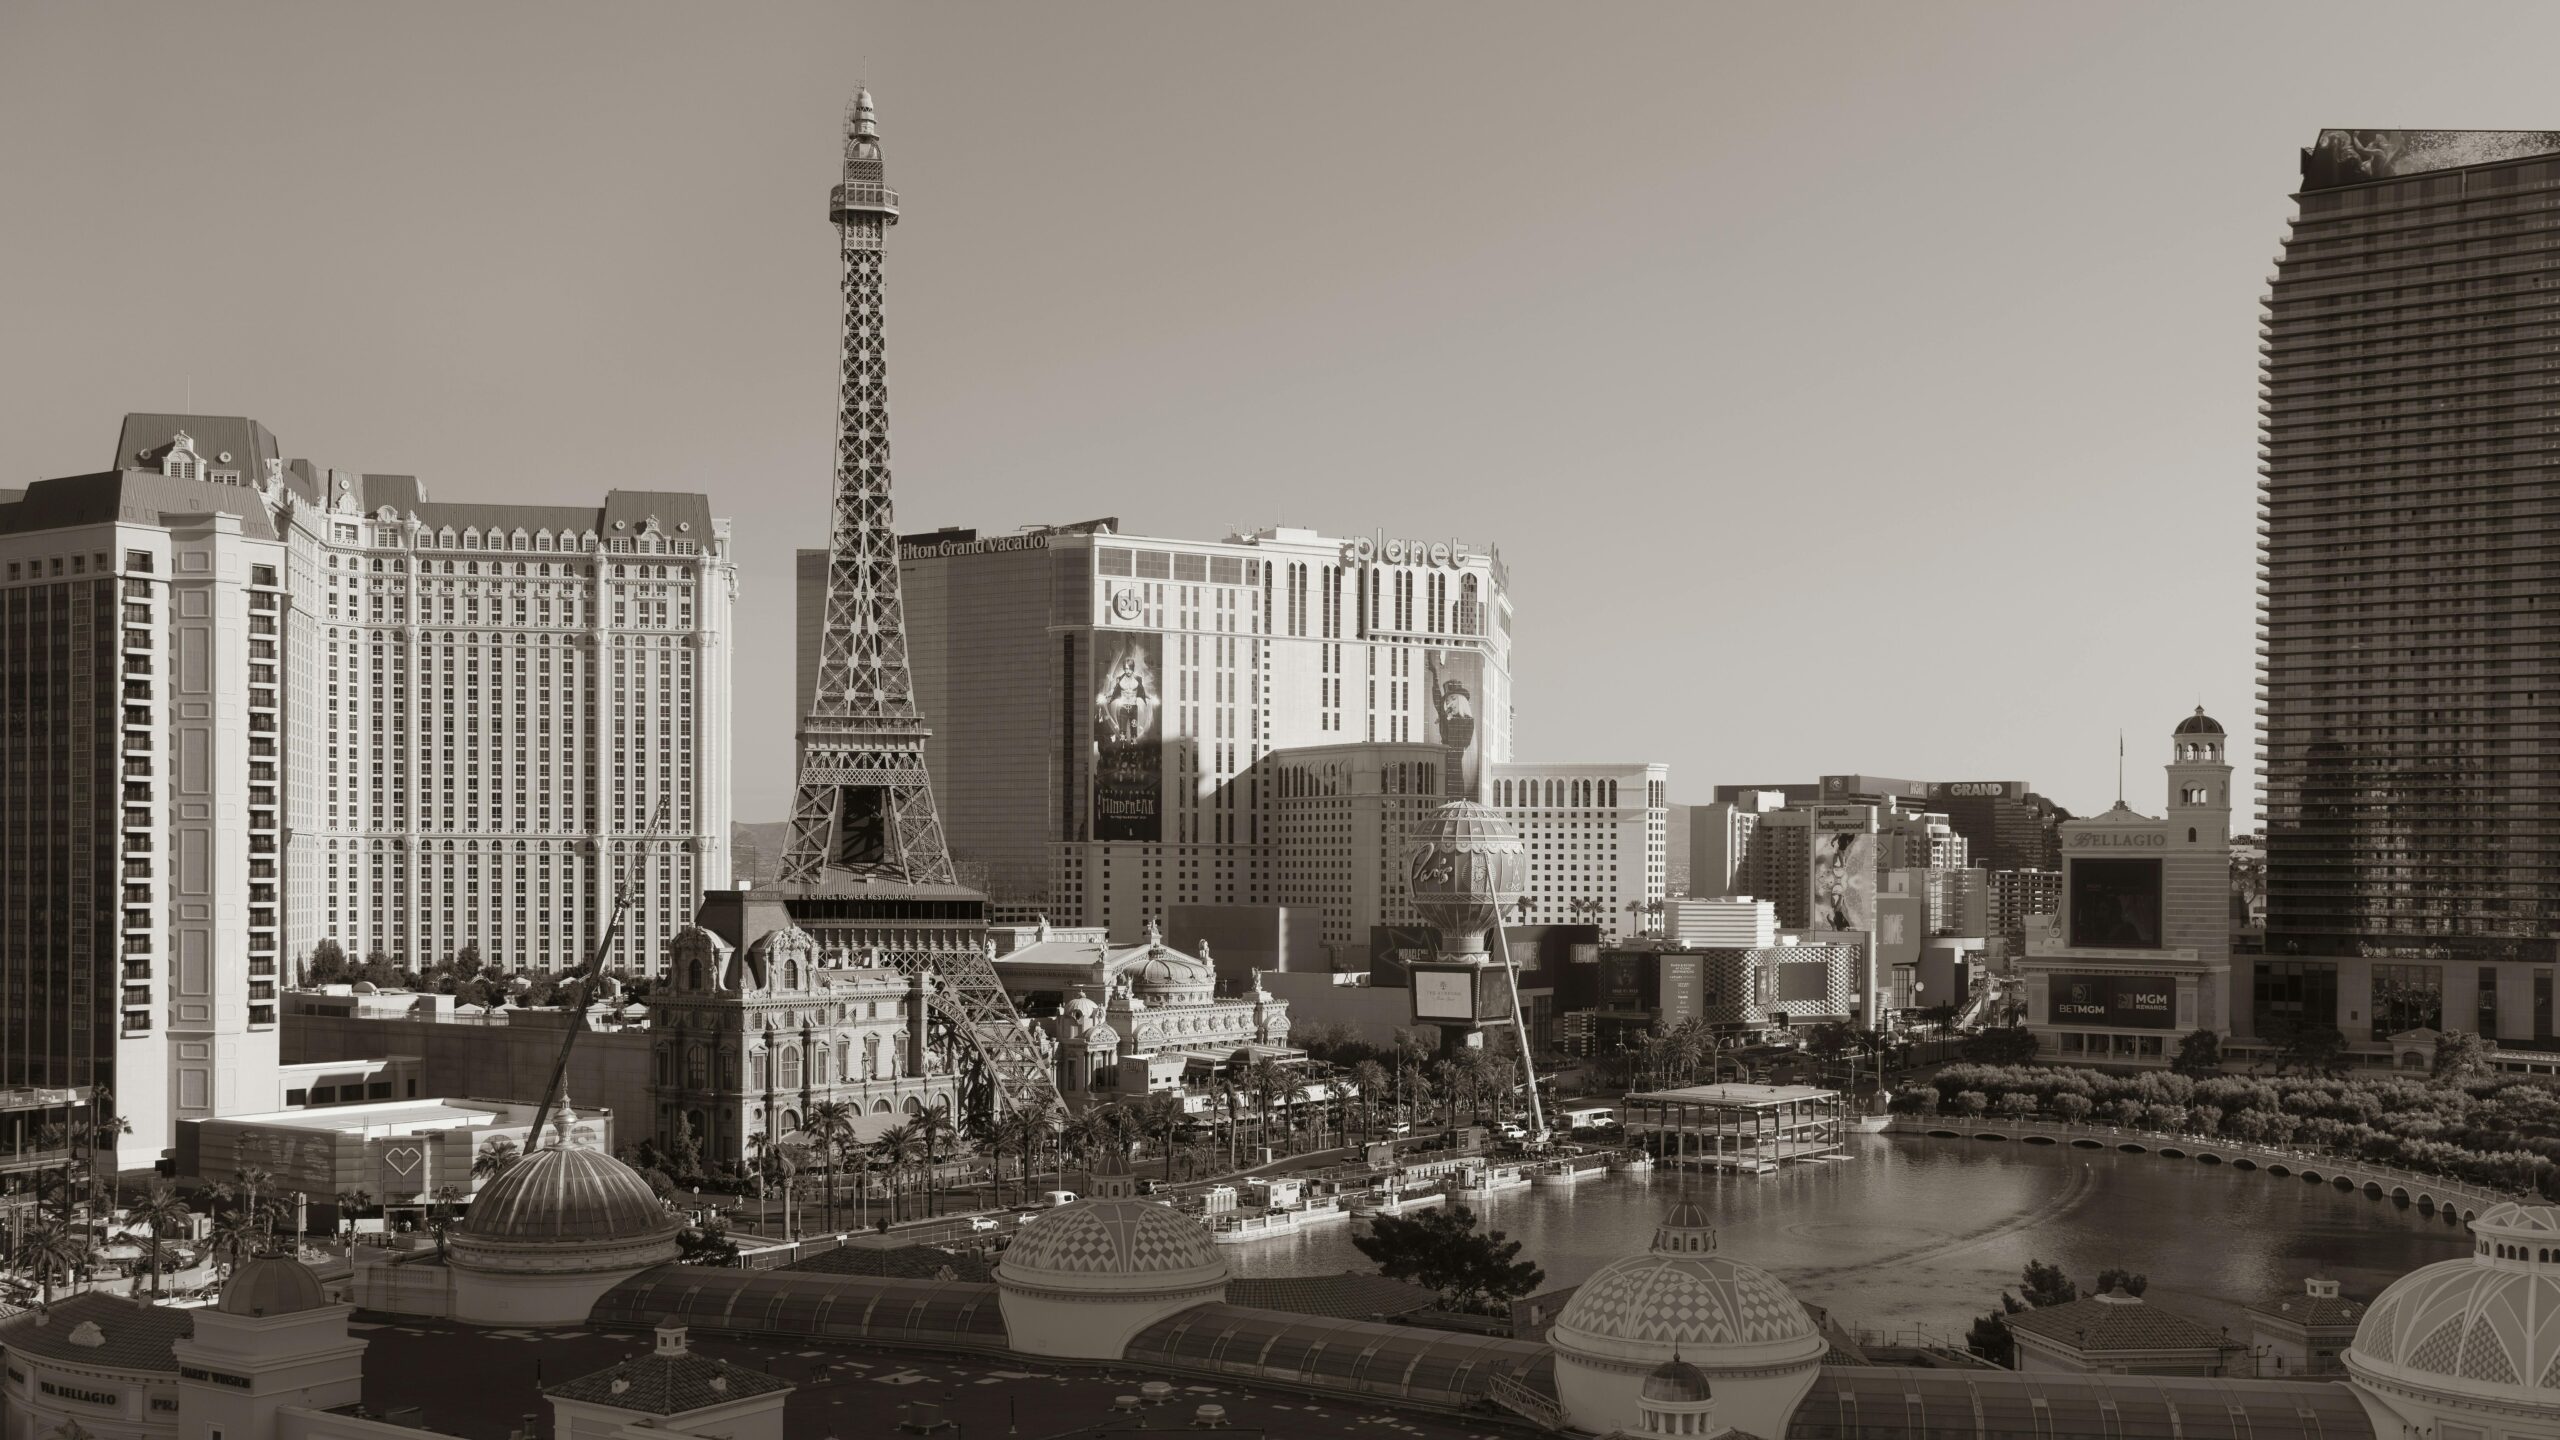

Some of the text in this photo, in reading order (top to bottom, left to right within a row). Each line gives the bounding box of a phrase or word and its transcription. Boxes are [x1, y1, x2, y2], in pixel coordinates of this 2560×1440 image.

[941, 538, 985, 557] Grand
[1354, 528, 1470, 569] planet
[1951, 783, 2003, 797] GRAND
[1818, 807, 1849, 819] planet
[1818, 821, 1865, 832] hollywood
[2069, 832, 2166, 848] BELLAGIO
[2136, 993, 2168, 1005] MGM
[2059, 1004, 2105, 1014] BETMGM
[181, 1367, 251, 1389] HARRY WINSTON
[41, 1381, 117, 1406] VIA BELLAGIO
